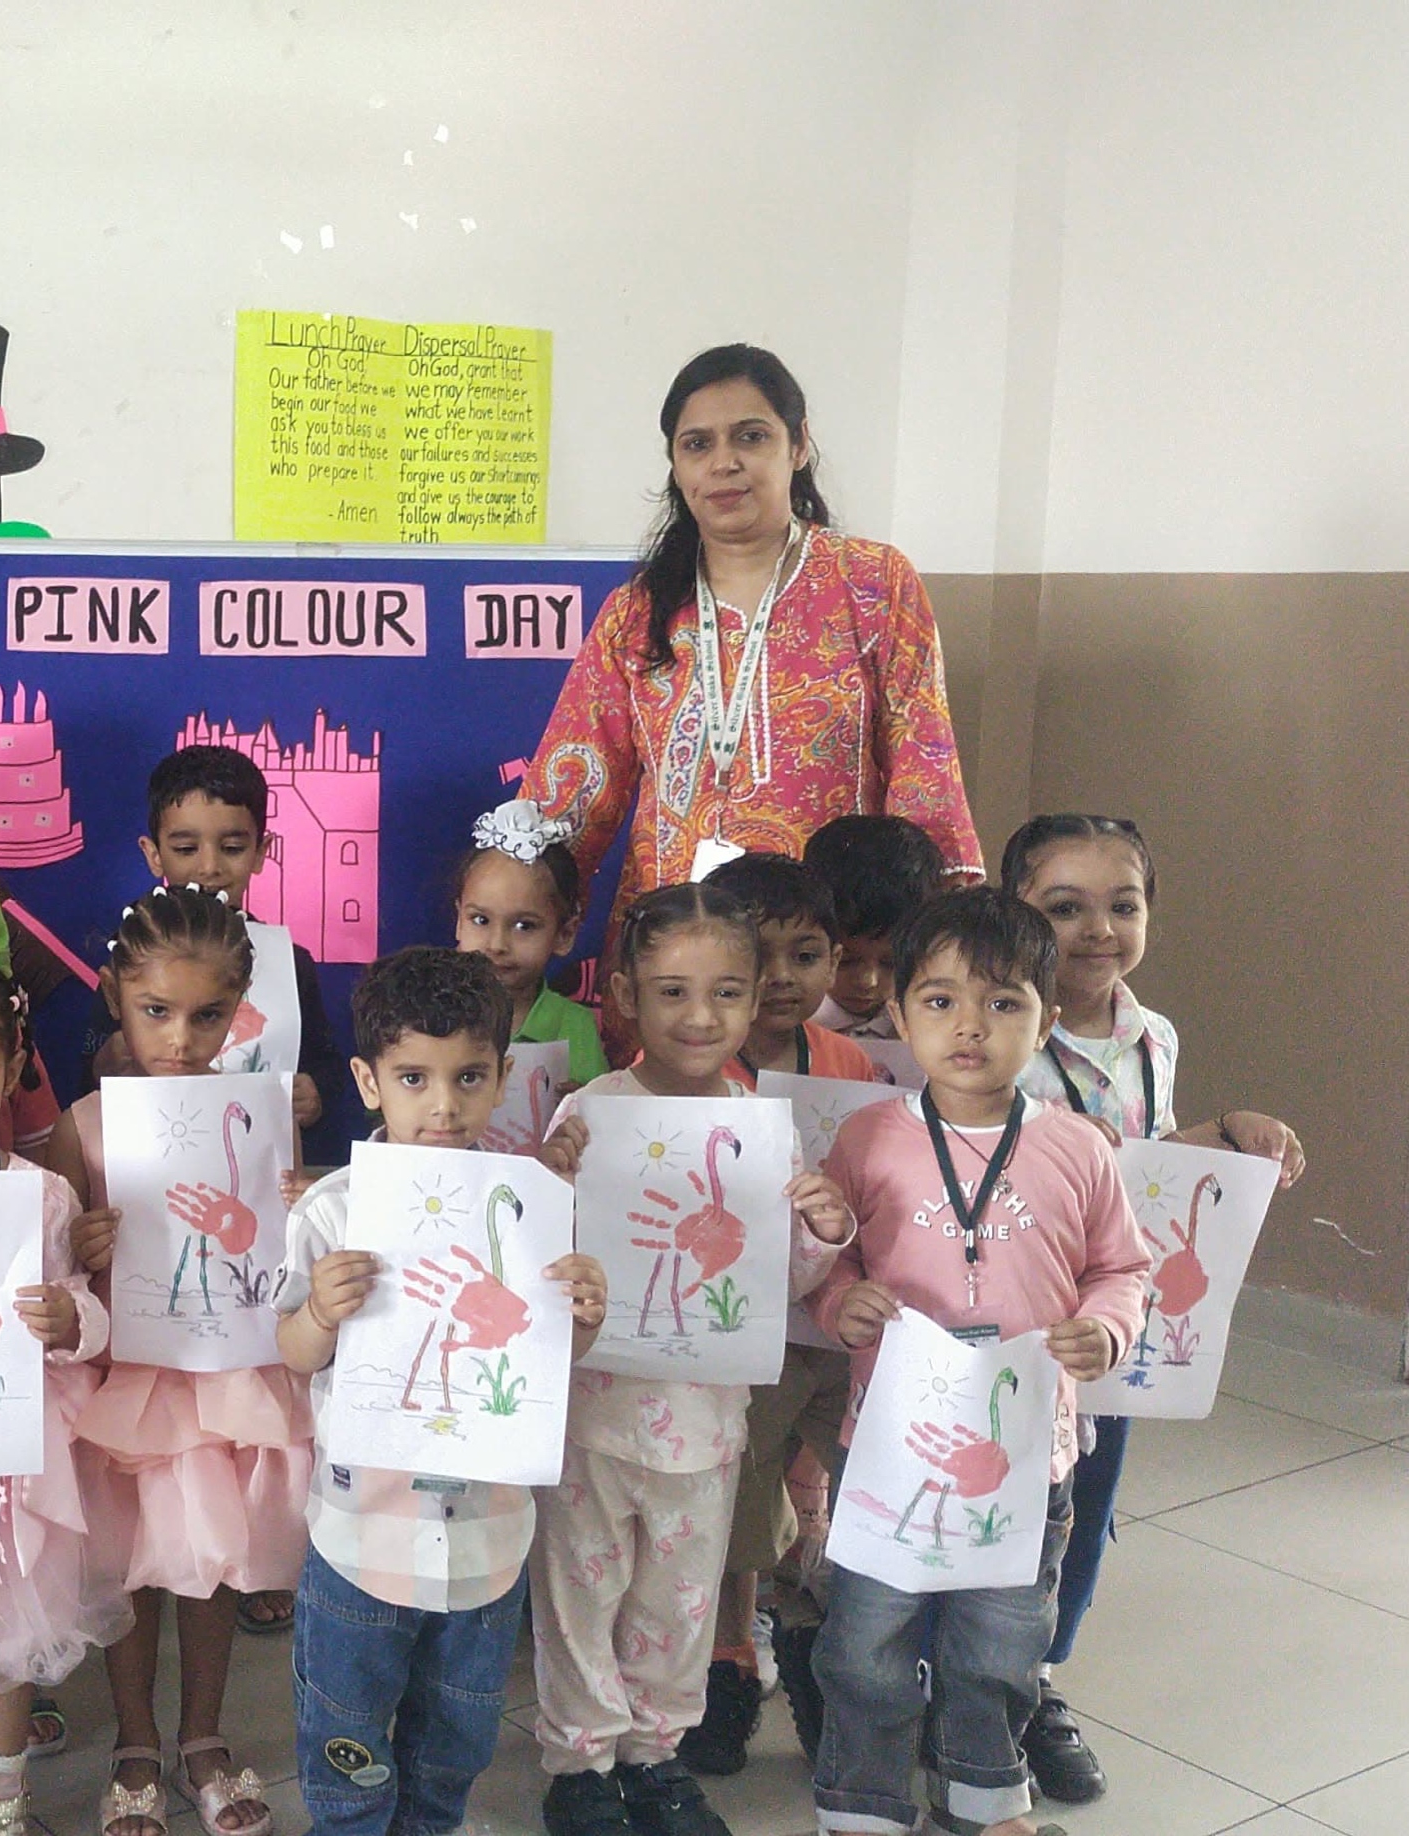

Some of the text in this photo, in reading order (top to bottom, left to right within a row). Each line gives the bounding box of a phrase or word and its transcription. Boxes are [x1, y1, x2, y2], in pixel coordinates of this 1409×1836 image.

[271, 311, 387, 359] Lunch Prayer
[403, 324, 527, 361] Dispersal Prayer
[307, 347, 332, 370] Oh
[408, 358, 429, 377] Oh
[466, 361, 497, 382] grant
[501, 361, 523, 381] that
[268, 367, 397, 398] Our father before we
[405, 381, 528, 406] we may remember
[271, 392, 378, 417] begin our food we
[405, 399, 533, 423] what we have learnt
[270, 413, 298, 433] ask
[305, 420, 329, 439] you
[331, 415, 343, 435] to
[345, 416, 372, 438] bless
[404, 426, 430, 440] we
[434, 420, 473, 440] offer
[510, 427, 535, 442] work
[271, 433, 389, 460] this food and those
[400, 447, 419, 461] our
[421, 441, 470, 462] failures
[471, 444, 492, 462] and
[270, 455, 298, 477] who
[308, 462, 359, 487] prepare
[399, 463, 445, 490] forgive
[450, 470, 467, 484] us
[397, 485, 535, 511] and give us the courage to
[337, 499, 379, 523] Amen
[398, 504, 538, 531] follow always the path of
[400, 525, 440, 544] truth
[14, 585, 575, 649] PINK COLOUR DAY
[942, 1222, 1010, 1241] GME
